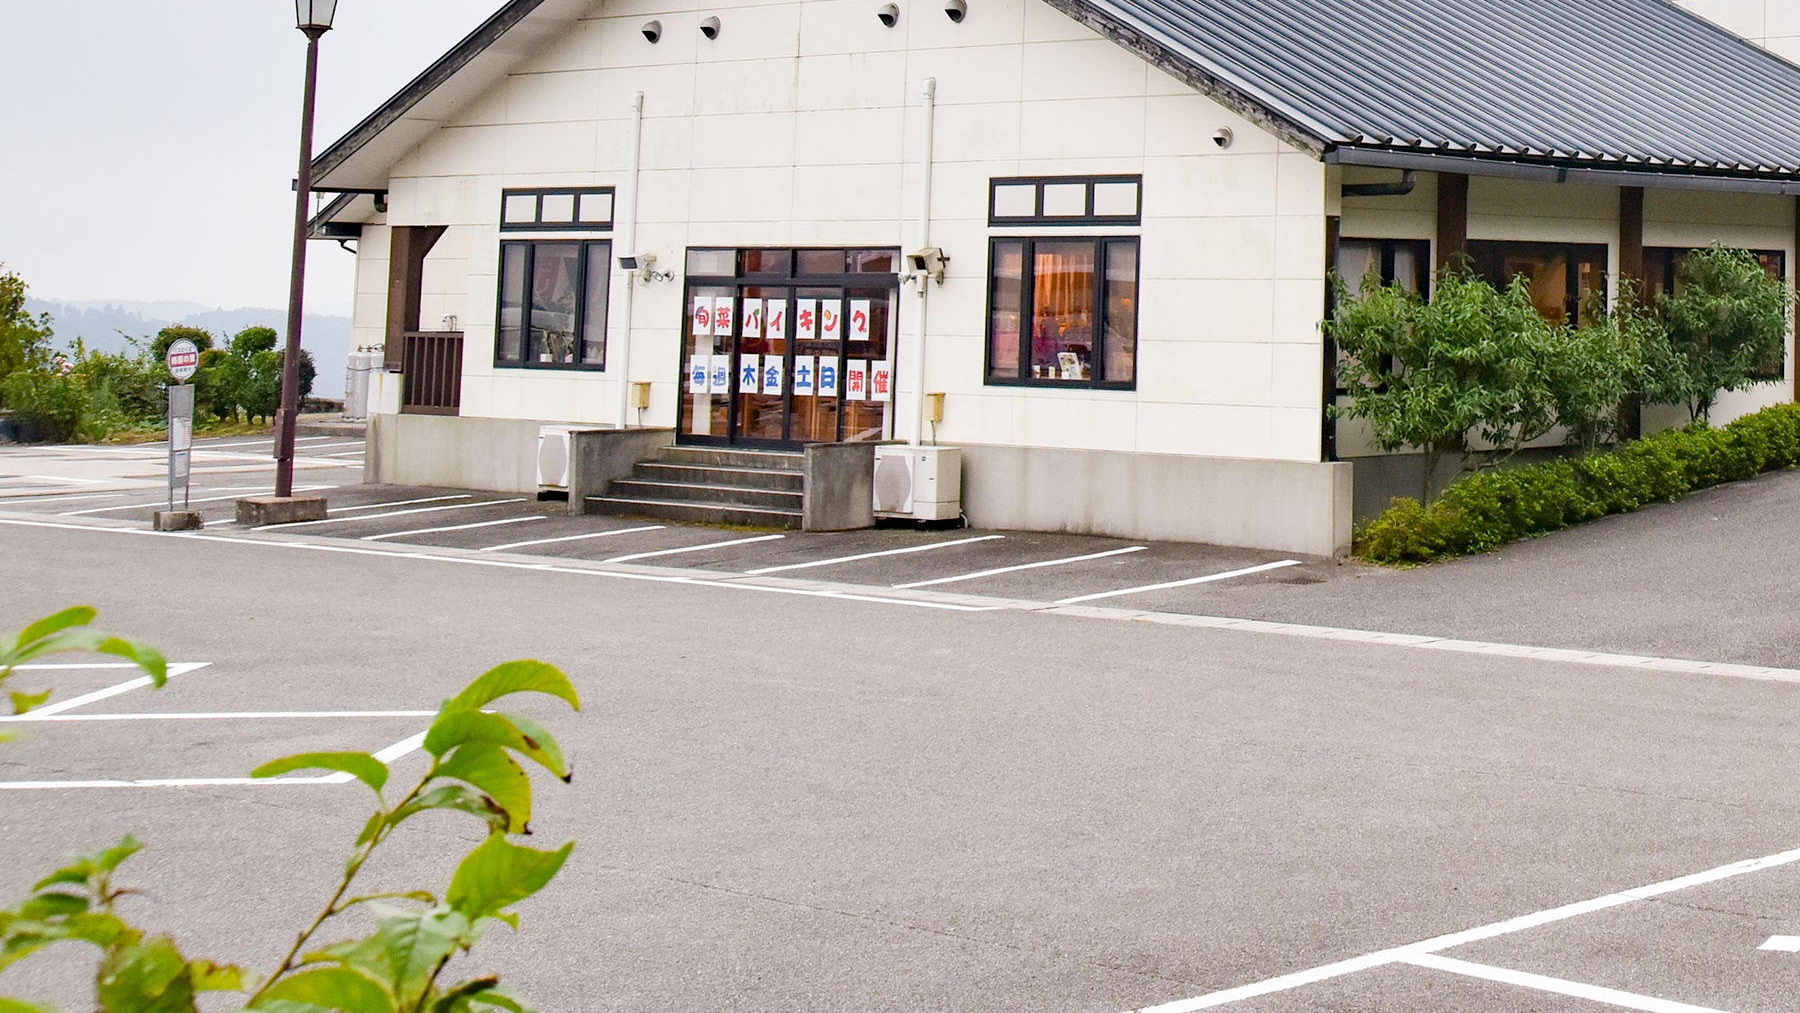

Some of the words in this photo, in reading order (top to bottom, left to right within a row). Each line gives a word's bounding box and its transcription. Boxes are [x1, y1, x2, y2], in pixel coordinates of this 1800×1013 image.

[695, 305, 867, 333] 旬菜バイキング
[692, 364, 888, 394] 毎週木金土日開催
